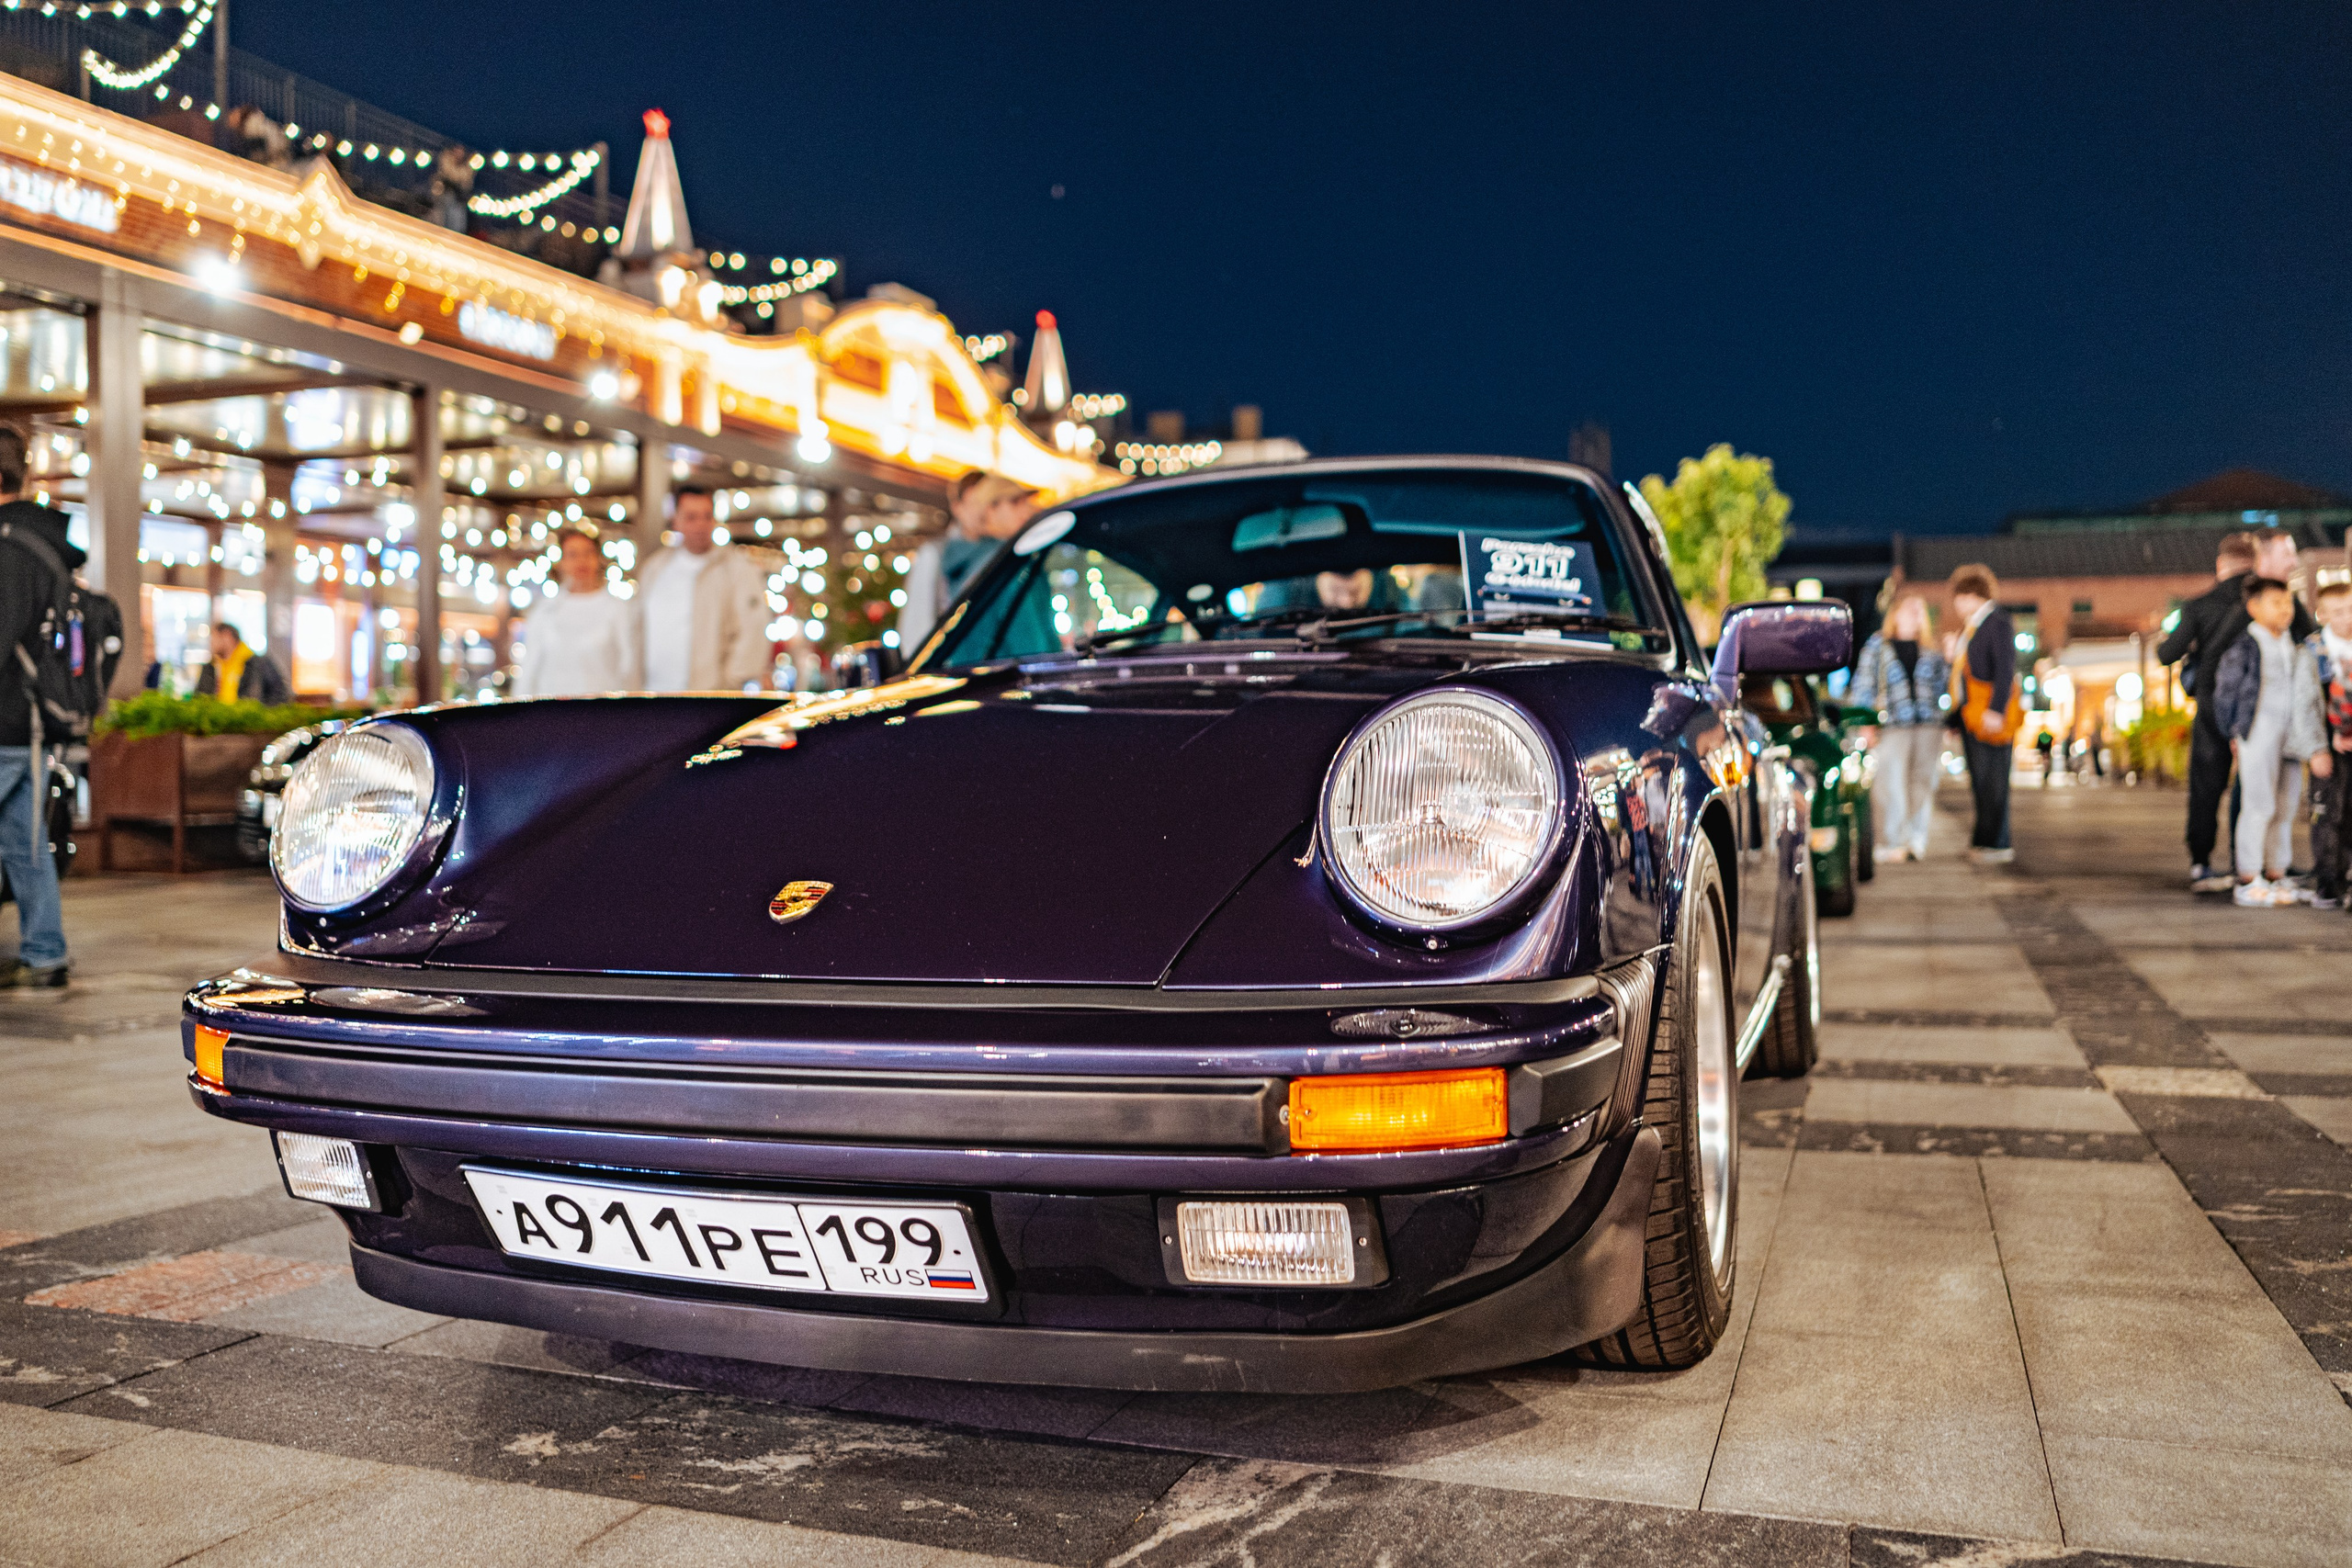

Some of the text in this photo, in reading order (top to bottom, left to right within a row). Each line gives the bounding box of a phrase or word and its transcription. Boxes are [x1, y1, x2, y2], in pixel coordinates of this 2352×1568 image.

[1490, 550, 1569, 580] 911
[816, 1215, 943, 1266] 199
[860, 1267, 925, 1286] RUS
